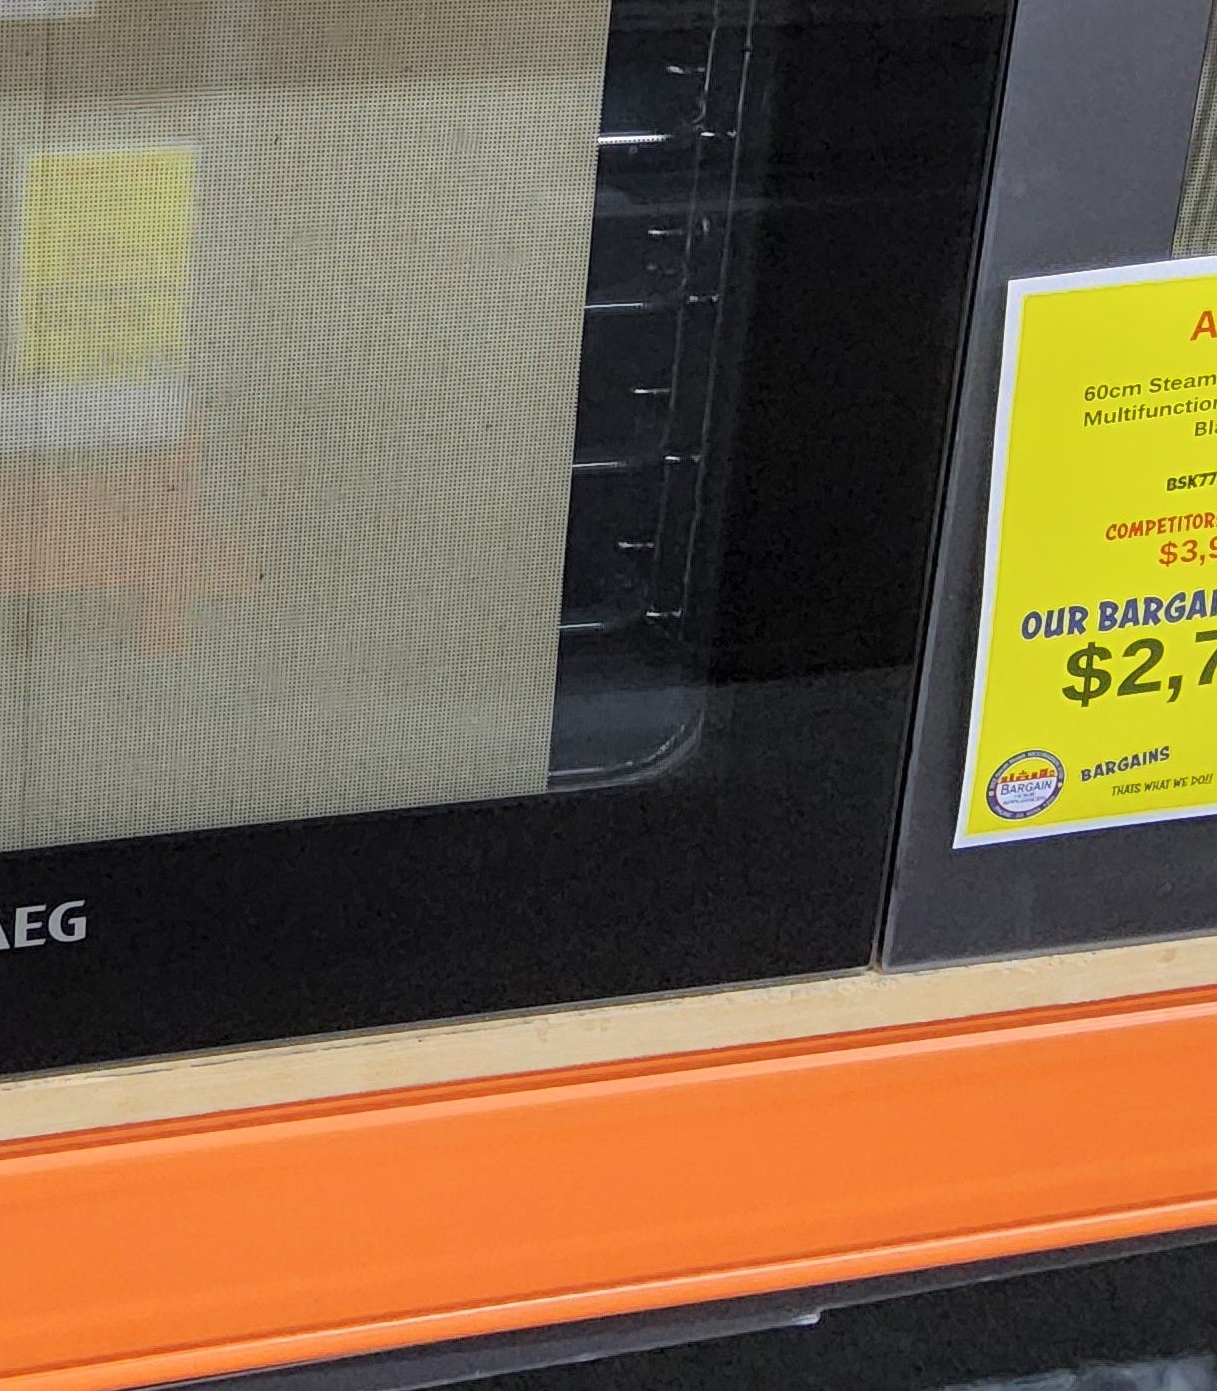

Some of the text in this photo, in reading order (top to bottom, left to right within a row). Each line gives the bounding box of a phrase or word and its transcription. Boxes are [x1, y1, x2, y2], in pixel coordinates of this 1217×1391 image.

[1084, 373, 1217, 401] 60cm Steam
[1194, 419, 1217, 437] Bl
[1105, 512, 1217, 541] COMPETITOR
[1021, 606, 1089, 640] OUR
[1080, 745, 1171, 782] BARGAINS
[1000, 779, 1053, 796] BARGAIN
[1144, 778, 1172, 792] WHAT
[1173, 776, 1189, 789] WE
